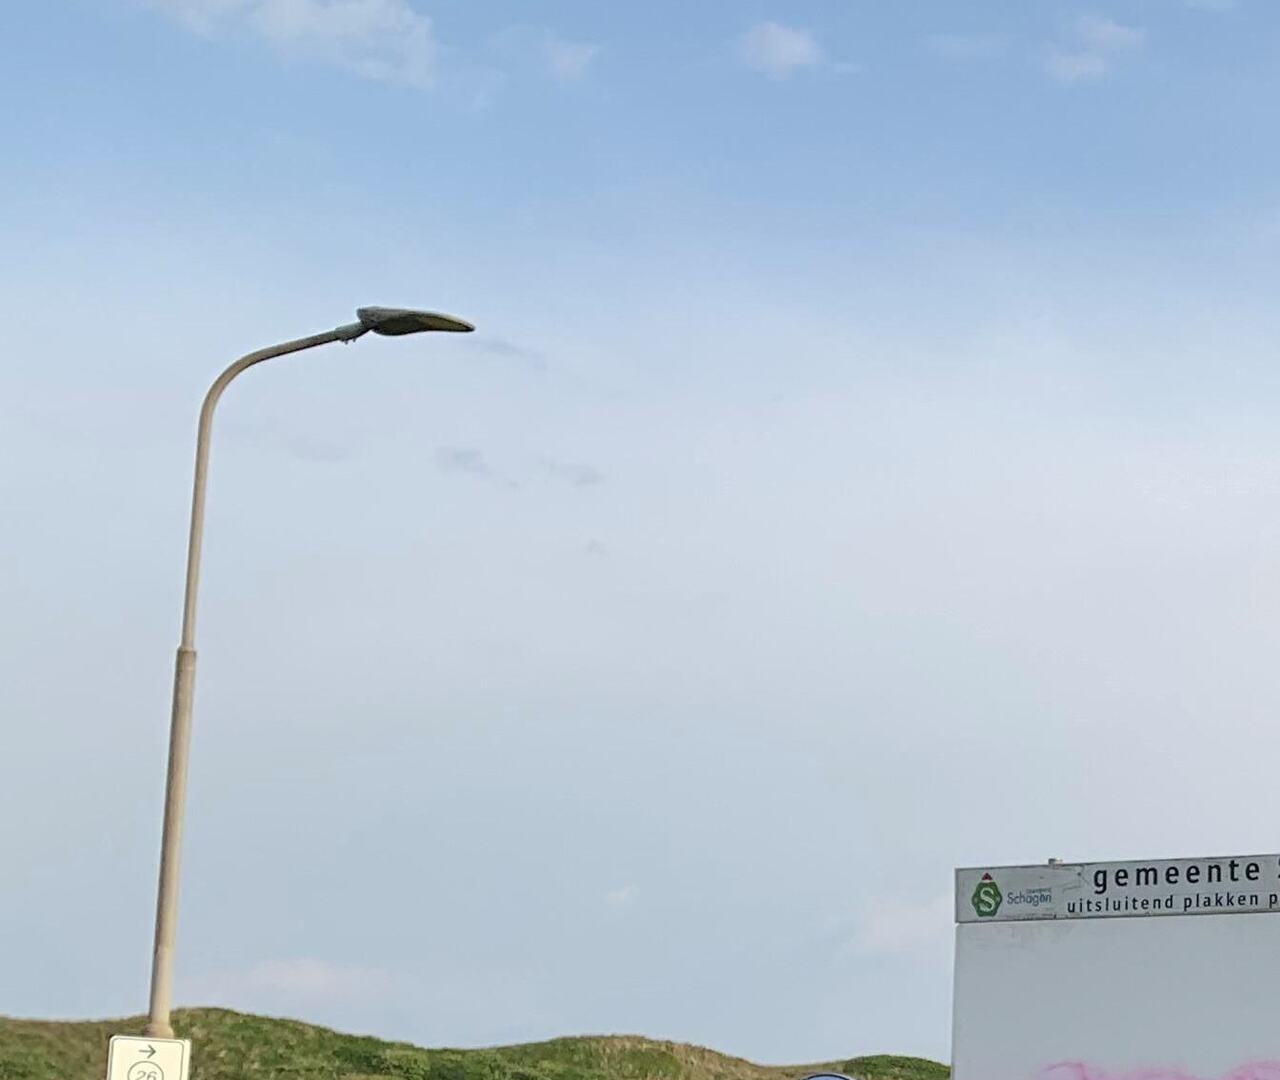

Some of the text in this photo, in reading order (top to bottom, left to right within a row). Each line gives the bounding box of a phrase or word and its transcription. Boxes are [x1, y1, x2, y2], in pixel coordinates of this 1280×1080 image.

[1093, 859, 1260, 895] gemeente
[1067, 894, 1175, 913] uitsluitend
[1183, 892, 1259, 912] plakken
